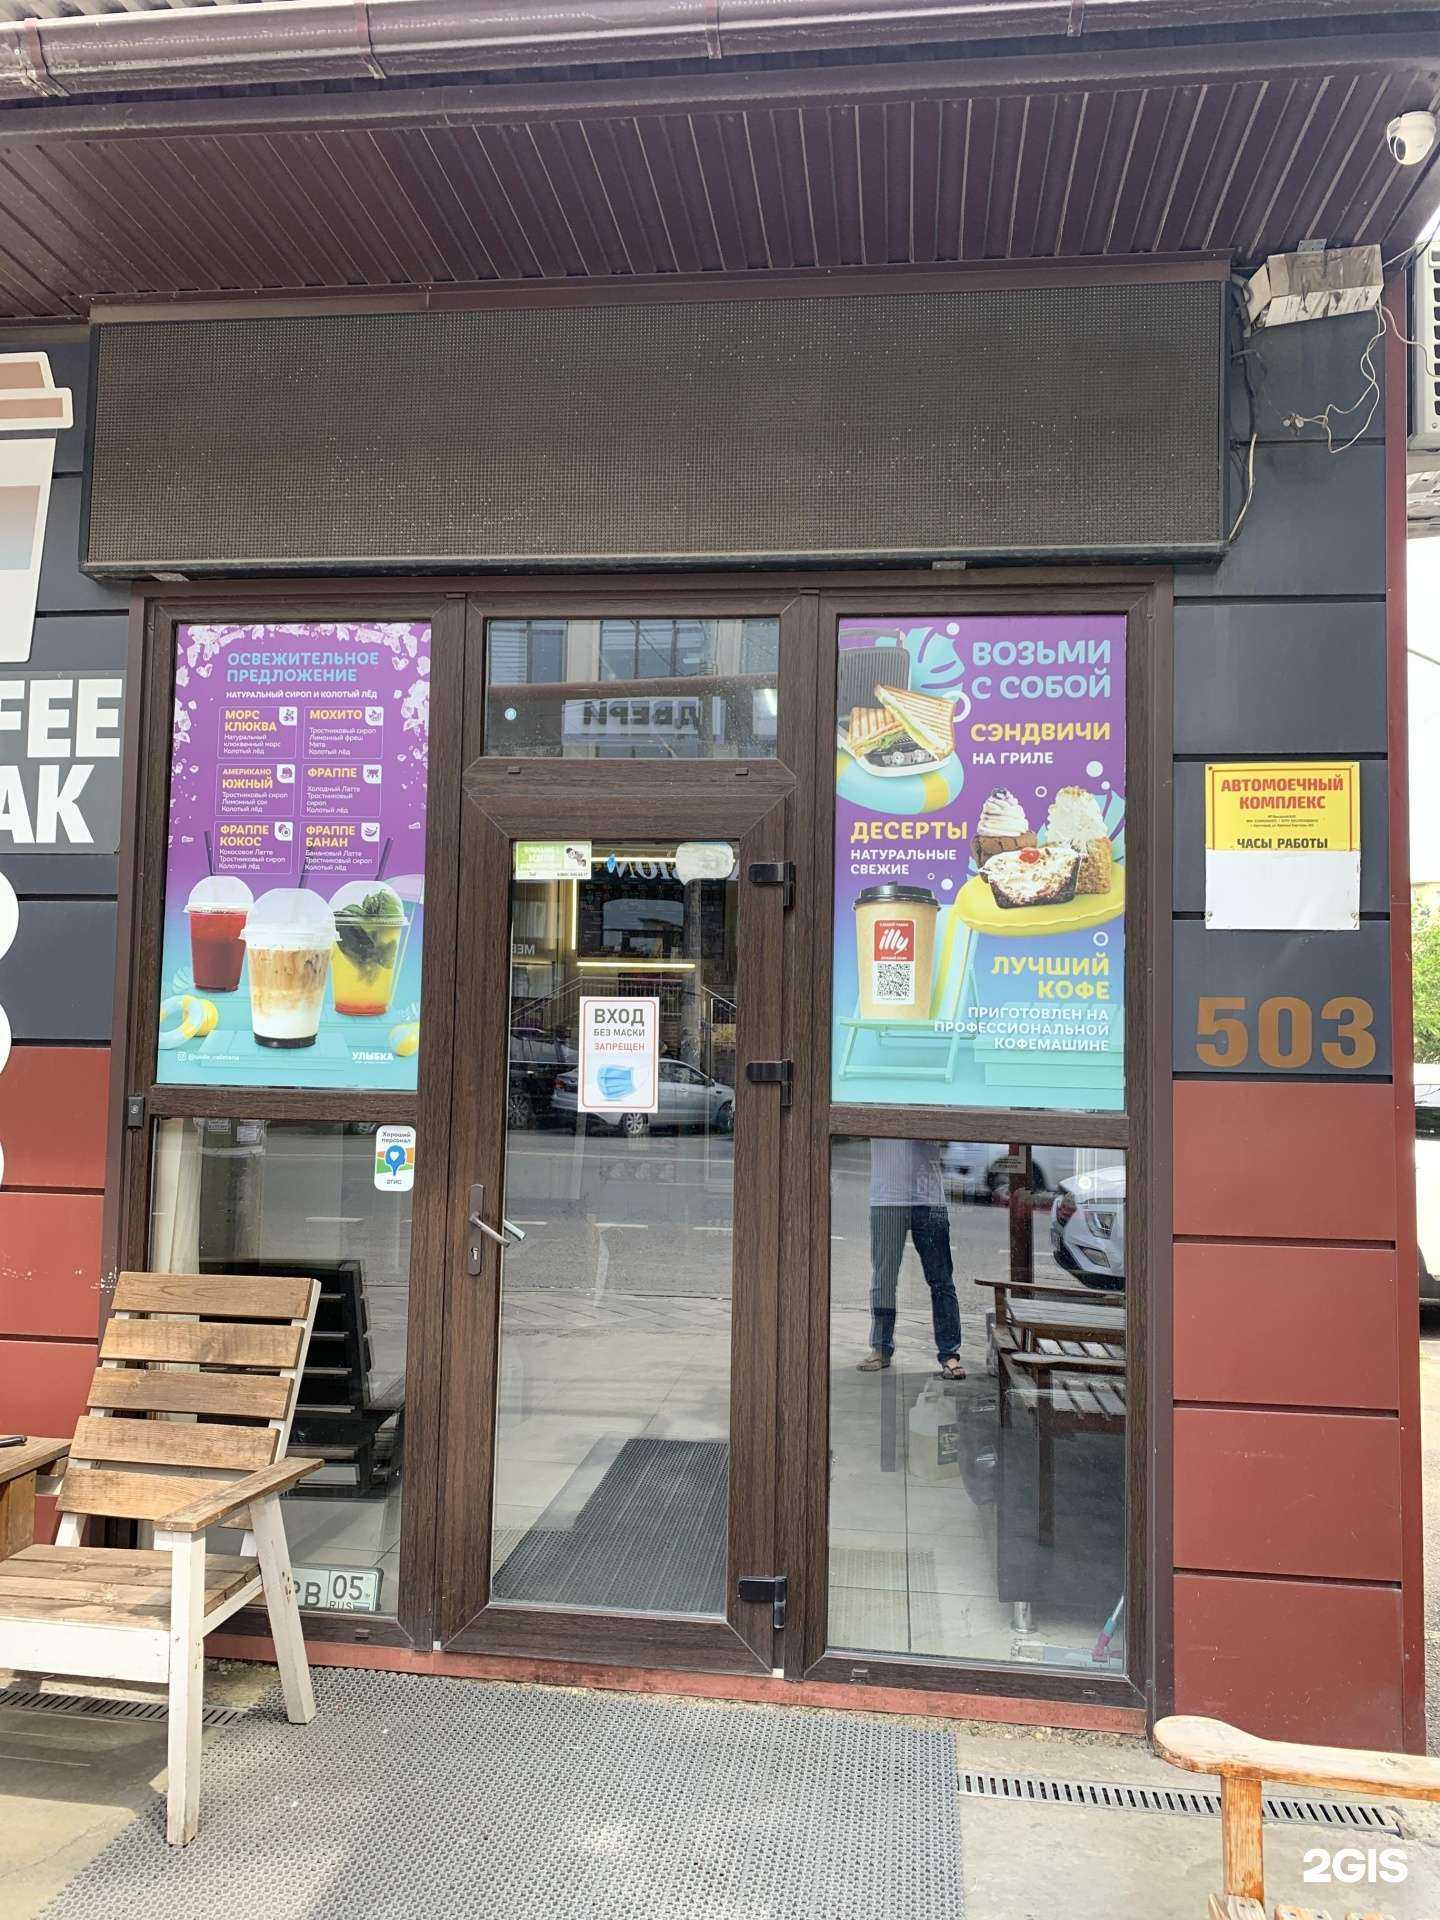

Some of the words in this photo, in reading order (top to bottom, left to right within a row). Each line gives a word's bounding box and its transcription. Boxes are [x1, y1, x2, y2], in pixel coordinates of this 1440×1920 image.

[227, 651, 380, 666] ОСВЕЖИТЕЛЬНОЕ
[972, 640, 1111, 666] ВОЗЬМИ
[226, 669, 357, 685] ПРЕДЛОЖЕНИЕ
[971, 675, 992, 699] С
[1000, 667, 1111, 699] СОБОЙ
[225, 690, 284, 699] НАТУРАЛЬНЫЙ
[285, 690, 312, 699] СИРОП
[313, 690, 320, 698] И
[321, 689, 360, 699] КОЛОТЫЙ
[361, 689, 378, 699] ЛЁД
[225, 710, 260, 720] МОРС
[309, 710, 363, 720] МОХИТО
[224, 722, 277, 732] КЛЮКВА
[970, 722, 1111, 745] СЭНДВИЧИ
[972, 752, 995, 764] НА
[1000, 752, 1054, 764] ГРИЛЕ
[307, 767, 357, 778] ФРАППЕ
[222, 776, 273, 789] ЮЖНЫЙ
[1221, 774, 1344, 792] АВТОМОЕЧНЫЙ
[1239, 796, 1326, 809] КОМПЛЕКС
[220, 825, 269, 835] ФРАППЕ
[306, 825, 356, 836] ФРАППЕ
[850, 821, 968, 843] ДЕСЕРТЫ
[219, 837, 262, 846] КОКОС
[305, 837, 348, 848] БАНАН
[1237, 838, 1272, 849] ЧАСЫ
[1277, 838, 1328, 849] РАБОТЫ
[850, 849, 957, 861] НАТУРАЛЬНЫЕ
[850, 864, 910, 875] СВЕЖИЕ
[879, 928, 909, 955] illy
[991, 952, 1110, 976] ЛУЧШИЙ
[1037, 980, 1110, 1000] КОФЕ
[594, 1008, 645, 1027] ВХОД
[968, 1006, 1083, 1021] ПРИГОТОВЛЕН
[1087, 1008, 1109, 1021] НА
[593, 1028, 611, 1037] БЕЗ
[613, 1028, 645, 1037] МАСКИ
[934, 1020, 1110, 1036] ПРОФЕССИОНАЛЬНОЙ
[1196, 996, 1377, 1069] 503
[594, 1042, 645, 1053] ЗАПРЕЩЕН
[994, 1037, 1109, 1052] КОФЕМАШИНЕ
[352, 1051, 394, 1061] УЛЫБКА
[332, 1574, 364, 1601] 05
[329, 1600, 352, 1610] RUS
